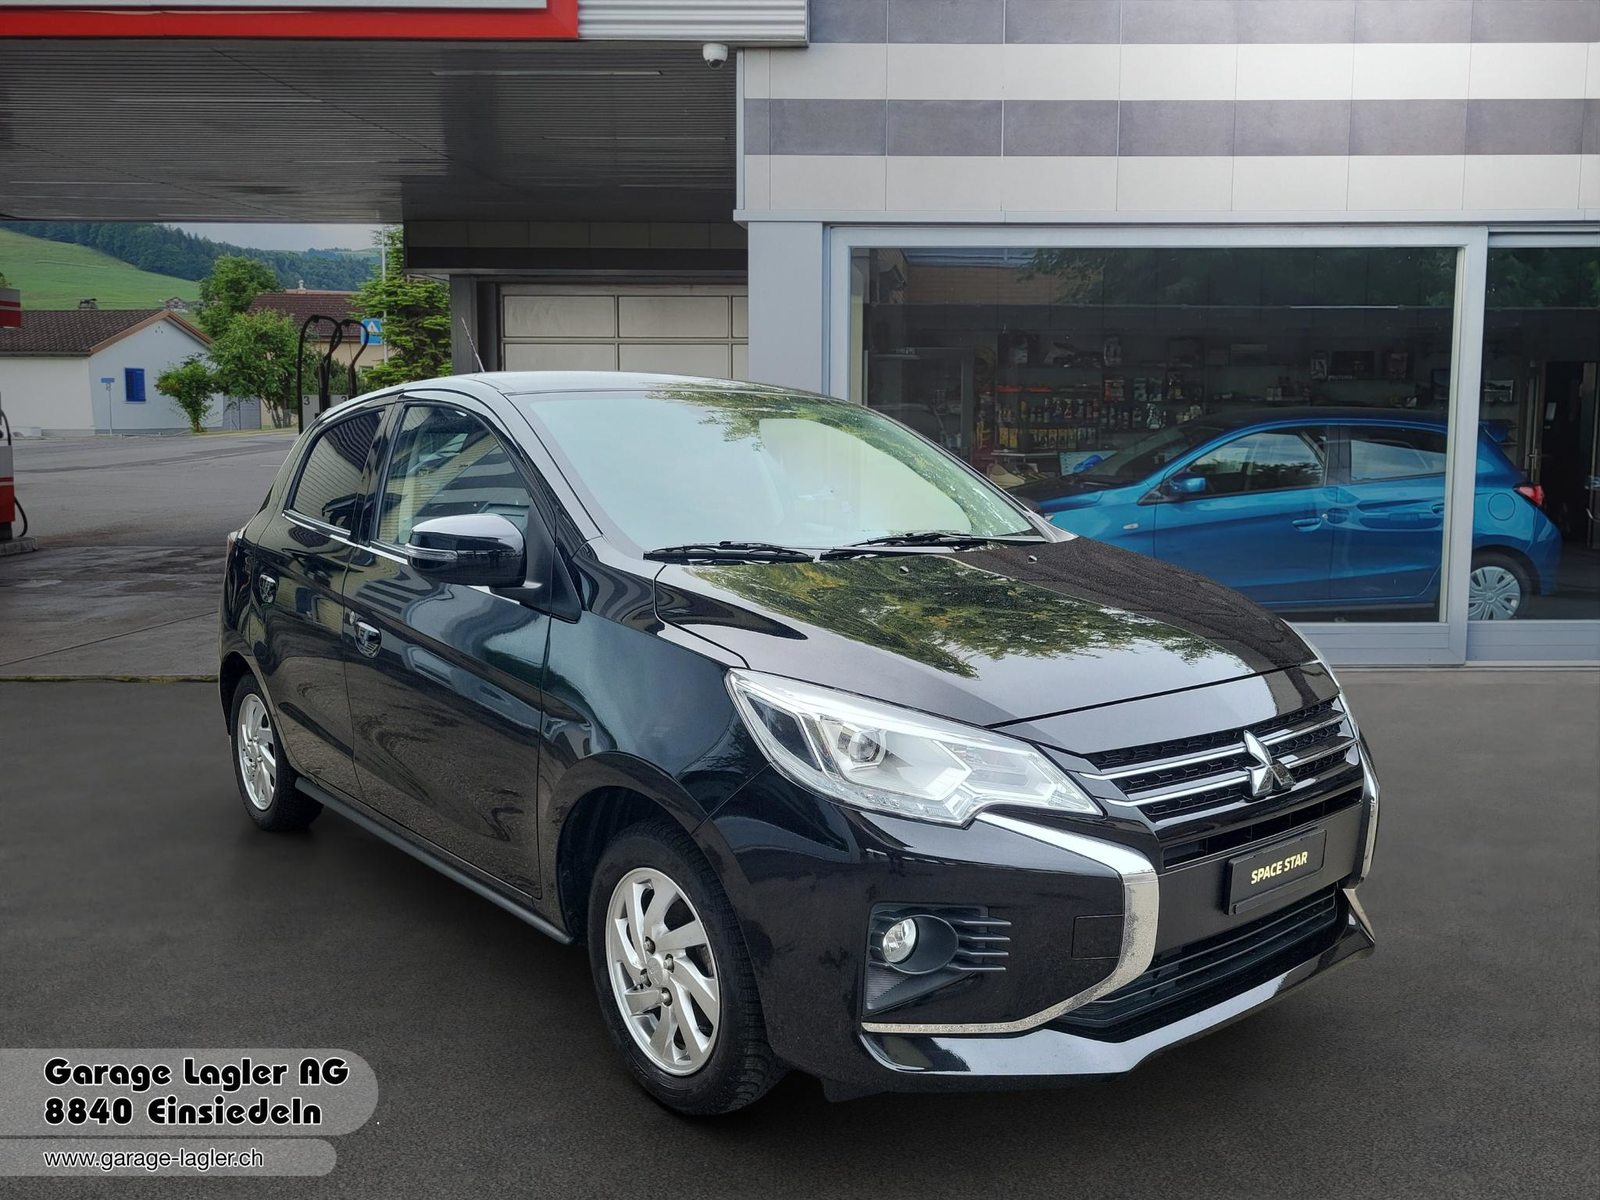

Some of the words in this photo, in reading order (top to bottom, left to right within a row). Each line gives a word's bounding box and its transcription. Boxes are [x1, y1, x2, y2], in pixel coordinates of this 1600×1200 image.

[303, 395, 310, 406] 3
[1251, 861, 1283, 885] SPACE
[1283, 851, 1308, 871] STAR
